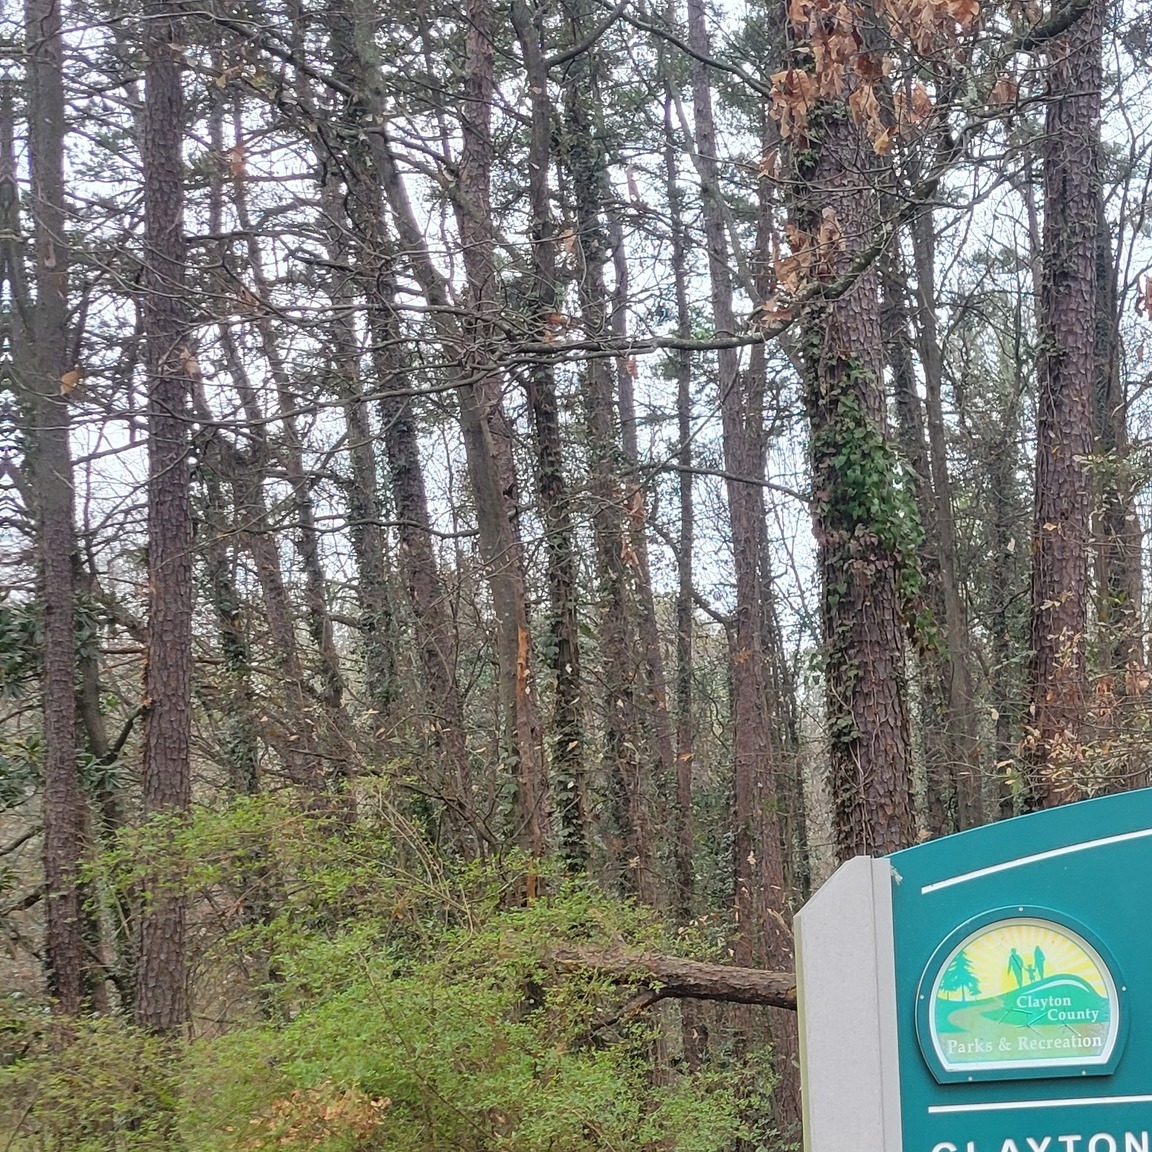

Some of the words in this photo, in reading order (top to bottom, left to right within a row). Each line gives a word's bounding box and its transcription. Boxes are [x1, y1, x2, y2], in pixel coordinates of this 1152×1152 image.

[1016, 995, 1072, 1010] Clayton
[1047, 1008, 1099, 1022] County
[947, 1038, 993, 1054] Parks
[998, 1037, 1012, 1051] &
[1018, 1035, 1102, 1051] Recreation
